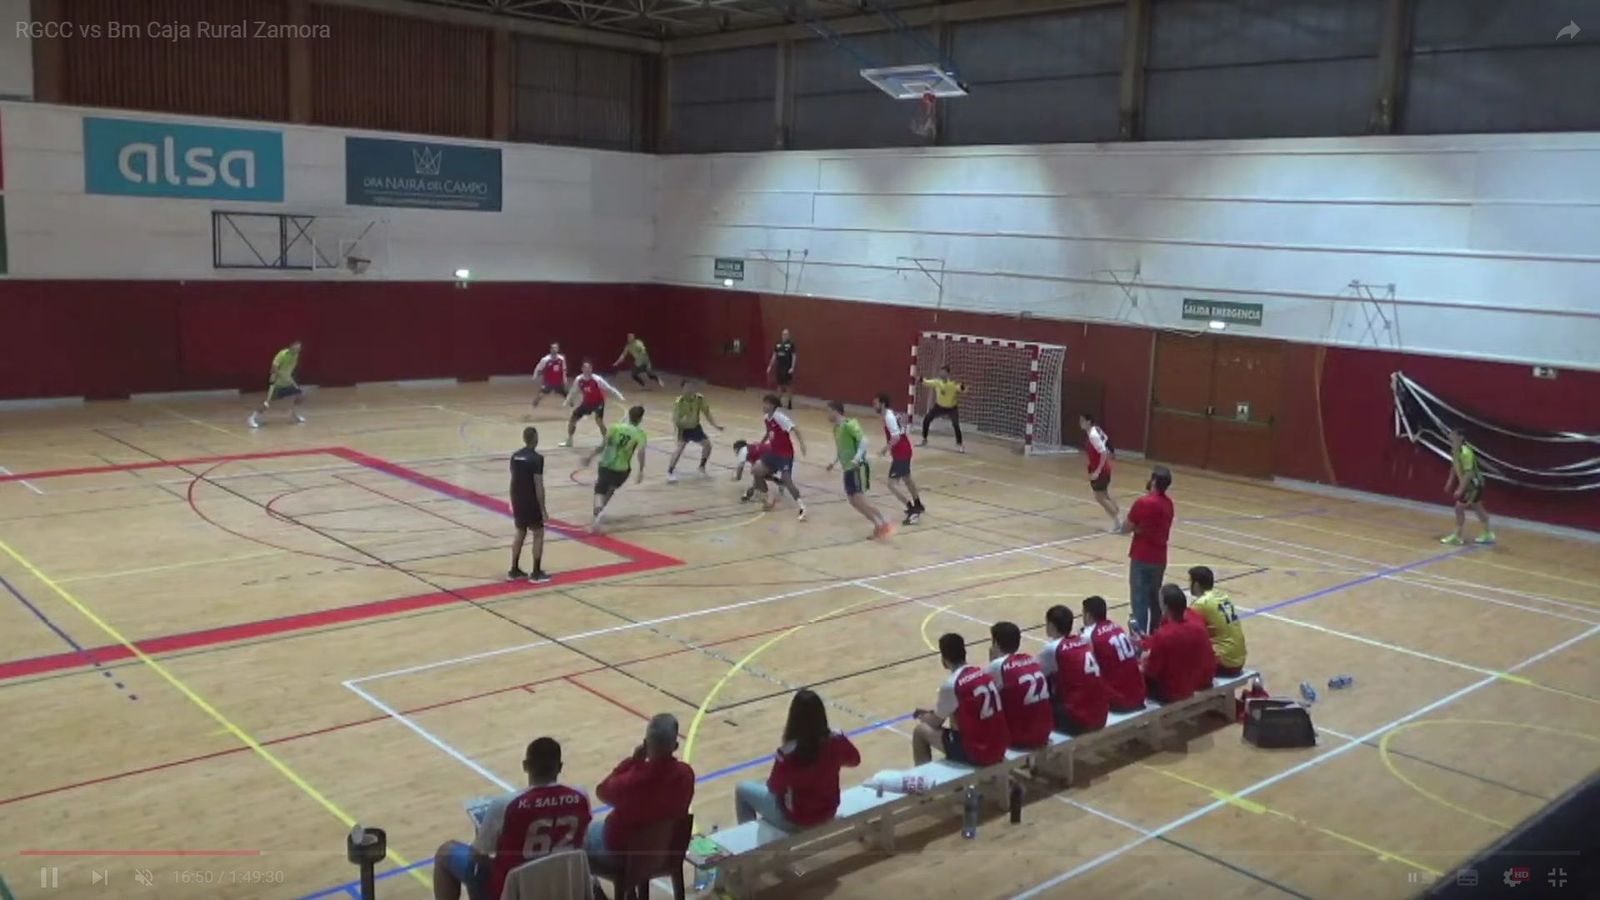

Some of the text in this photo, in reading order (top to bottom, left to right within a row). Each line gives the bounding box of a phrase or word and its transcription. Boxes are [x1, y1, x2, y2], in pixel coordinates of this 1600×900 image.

[118, 136, 255, 188] alsa
[444, 180, 488, 194] CAMPO
[1184, 304, 1261, 320] SALIDA EMERGENCIA
[1217, 601, 1238, 624] 12
[1109, 633, 1135, 661] 10
[1084, 651, 1100, 677] 4
[973, 681, 1002, 719] 21
[1018, 671, 1050, 705] 22
[535, 795, 579, 808] SALTOS
